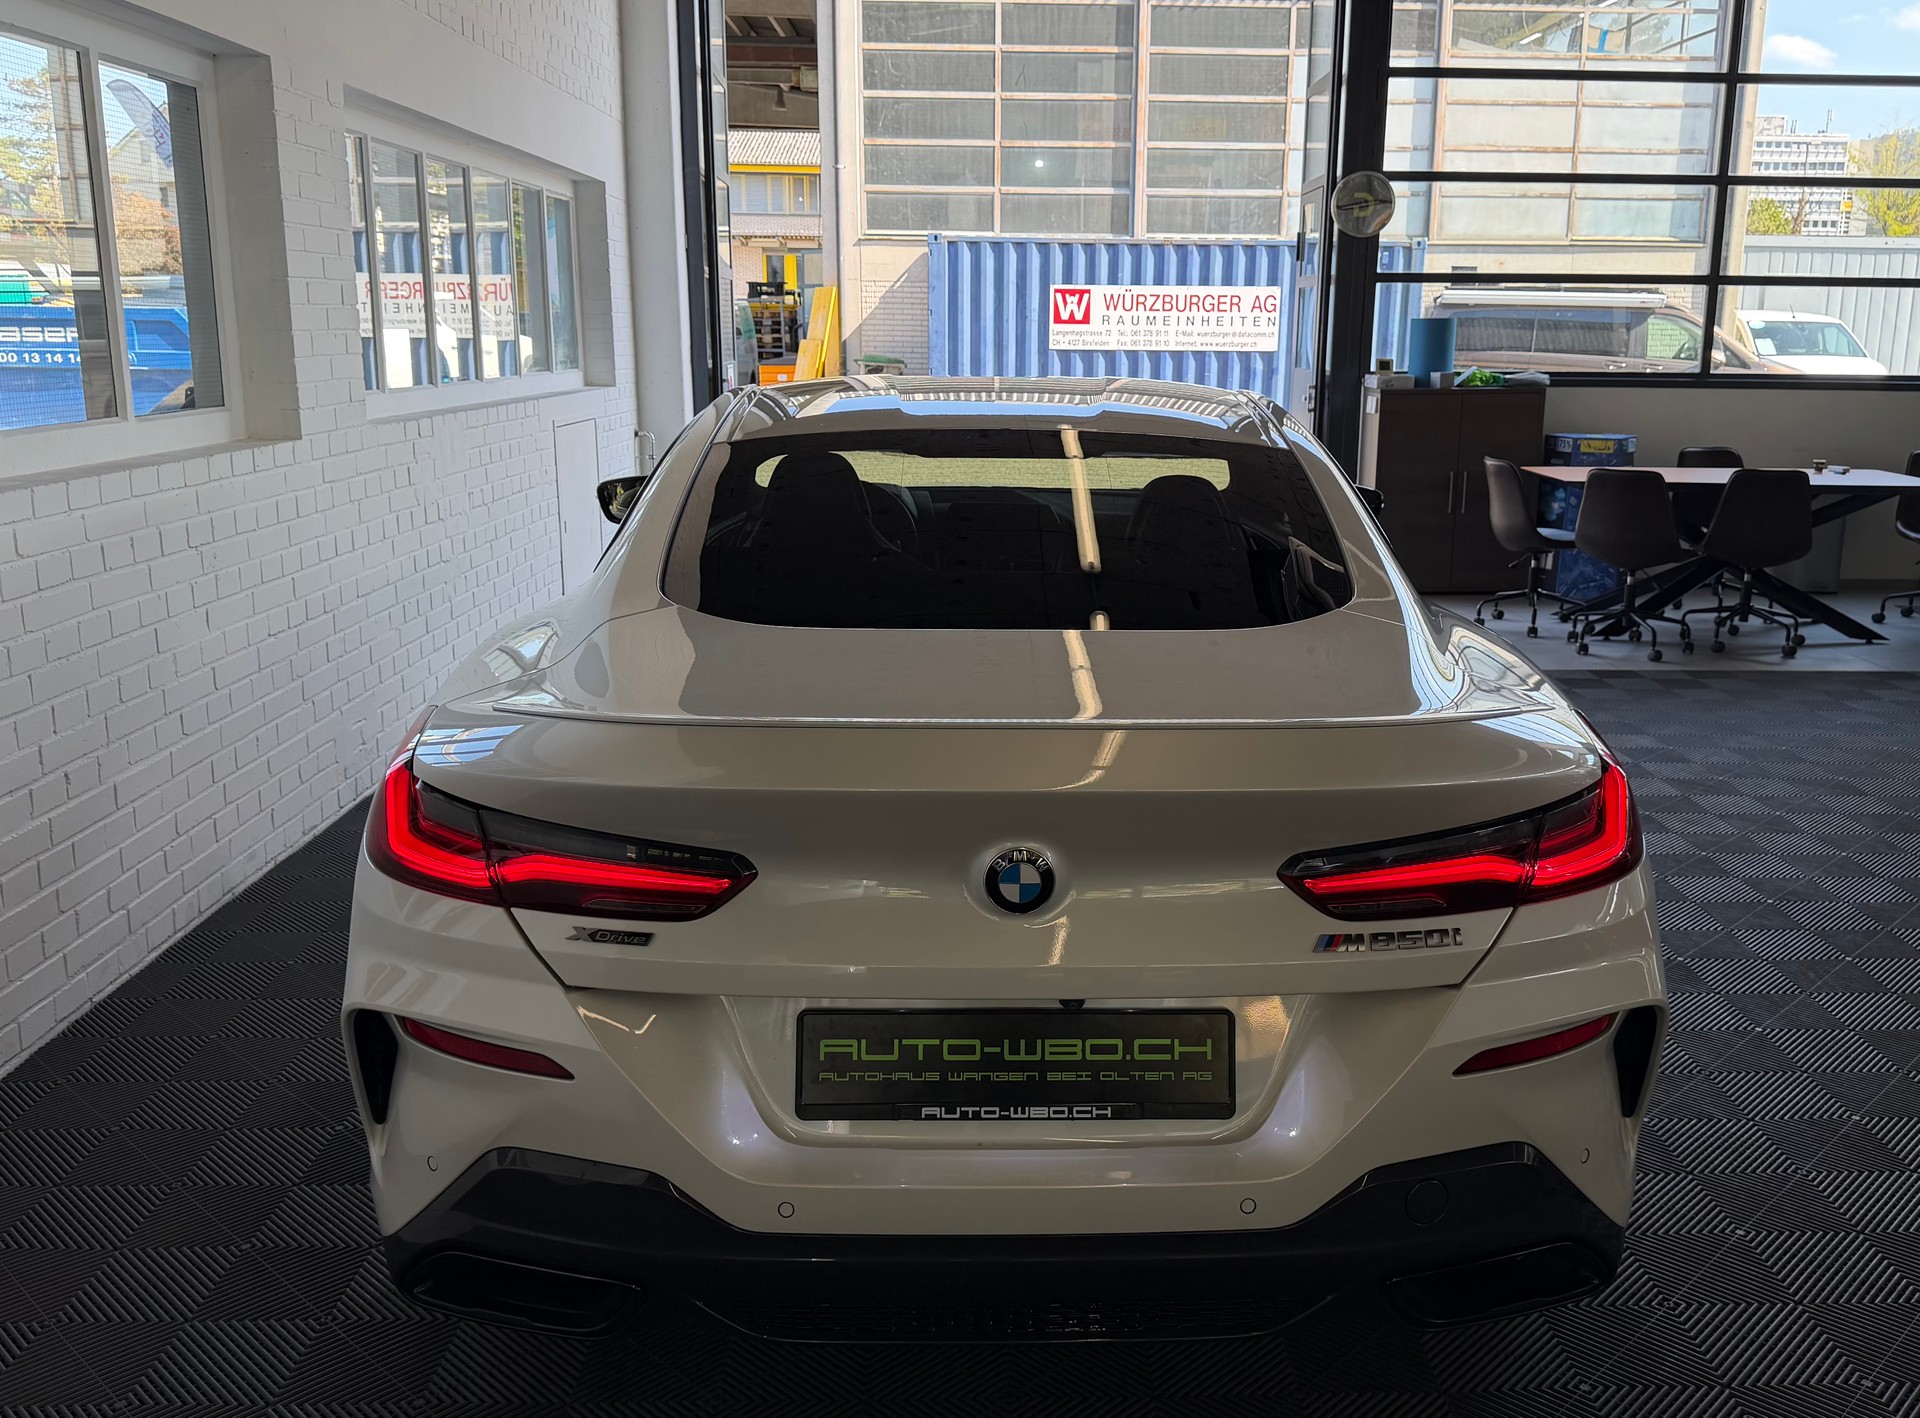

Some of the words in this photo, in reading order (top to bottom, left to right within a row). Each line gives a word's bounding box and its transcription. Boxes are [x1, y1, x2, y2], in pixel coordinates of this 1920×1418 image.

[1103, 289, 1242, 313] WÜRZBURGER
[1250, 294, 1277, 313] AG
[1101, 314, 1277, 327] RAUMEINHEITEN
[1105, 329, 1112, 337] 72
[1130, 329, 1141, 337] 061
[1143, 329, 1153, 337] 378
[1130, 339, 1141, 347] 061
[1143, 339, 1153, 347] 378
[23, 352, 40, 363] 13
[45, 353, 63, 364] 14
[991, 850, 1050, 873] BMW
[819, 1038, 1212, 1061] AUTO-WBO.CH
[819, 1072, 940, 1082] AUTOHAUS
[948, 1072, 1039, 1082] WANGEN
[1046, 1071, 1092, 1081] BEI
[1099, 1071, 1175, 1081] OLTEN
[1182, 1071, 1213, 1081] AG
[921, 1106, 1112, 1119] AUTO-WBO.CH
